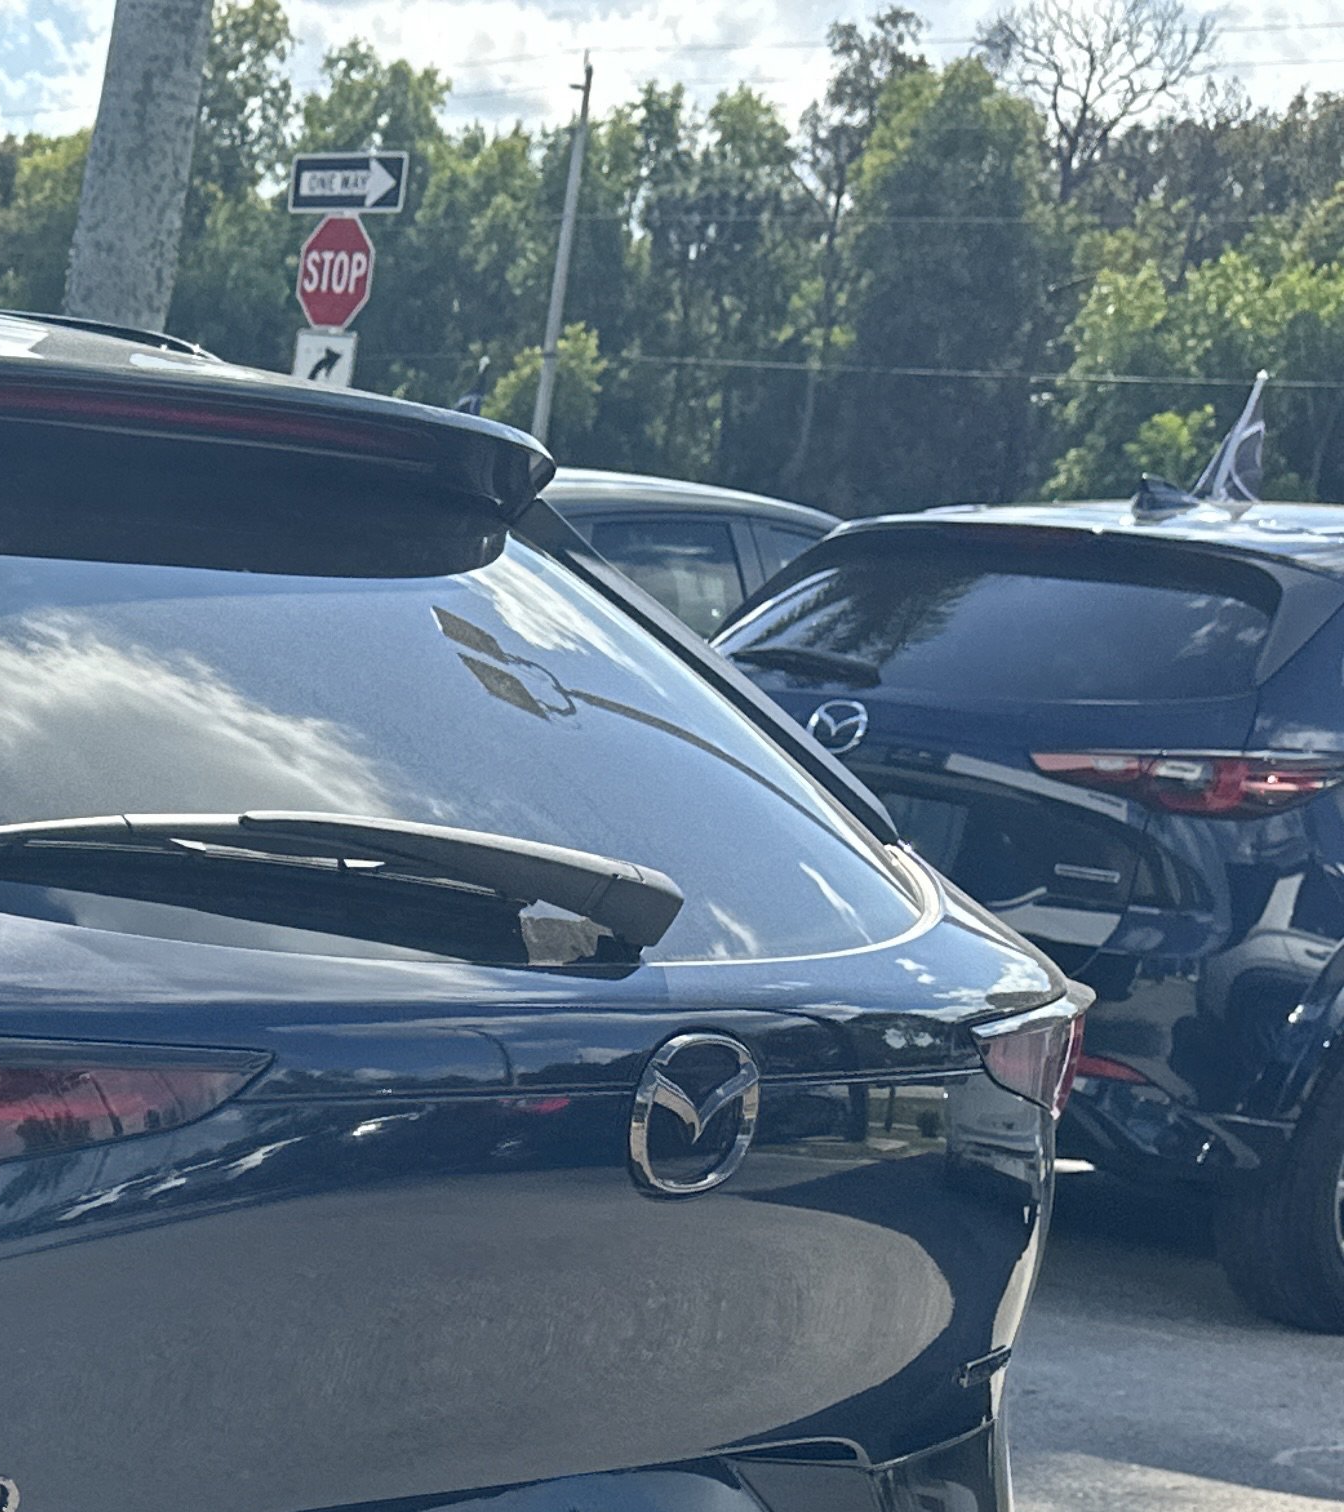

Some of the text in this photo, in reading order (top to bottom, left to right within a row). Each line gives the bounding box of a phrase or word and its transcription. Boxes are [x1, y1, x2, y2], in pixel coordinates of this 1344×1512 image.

[308, 173, 369, 192] ONE WAY
[303, 251, 367, 294] STOP
